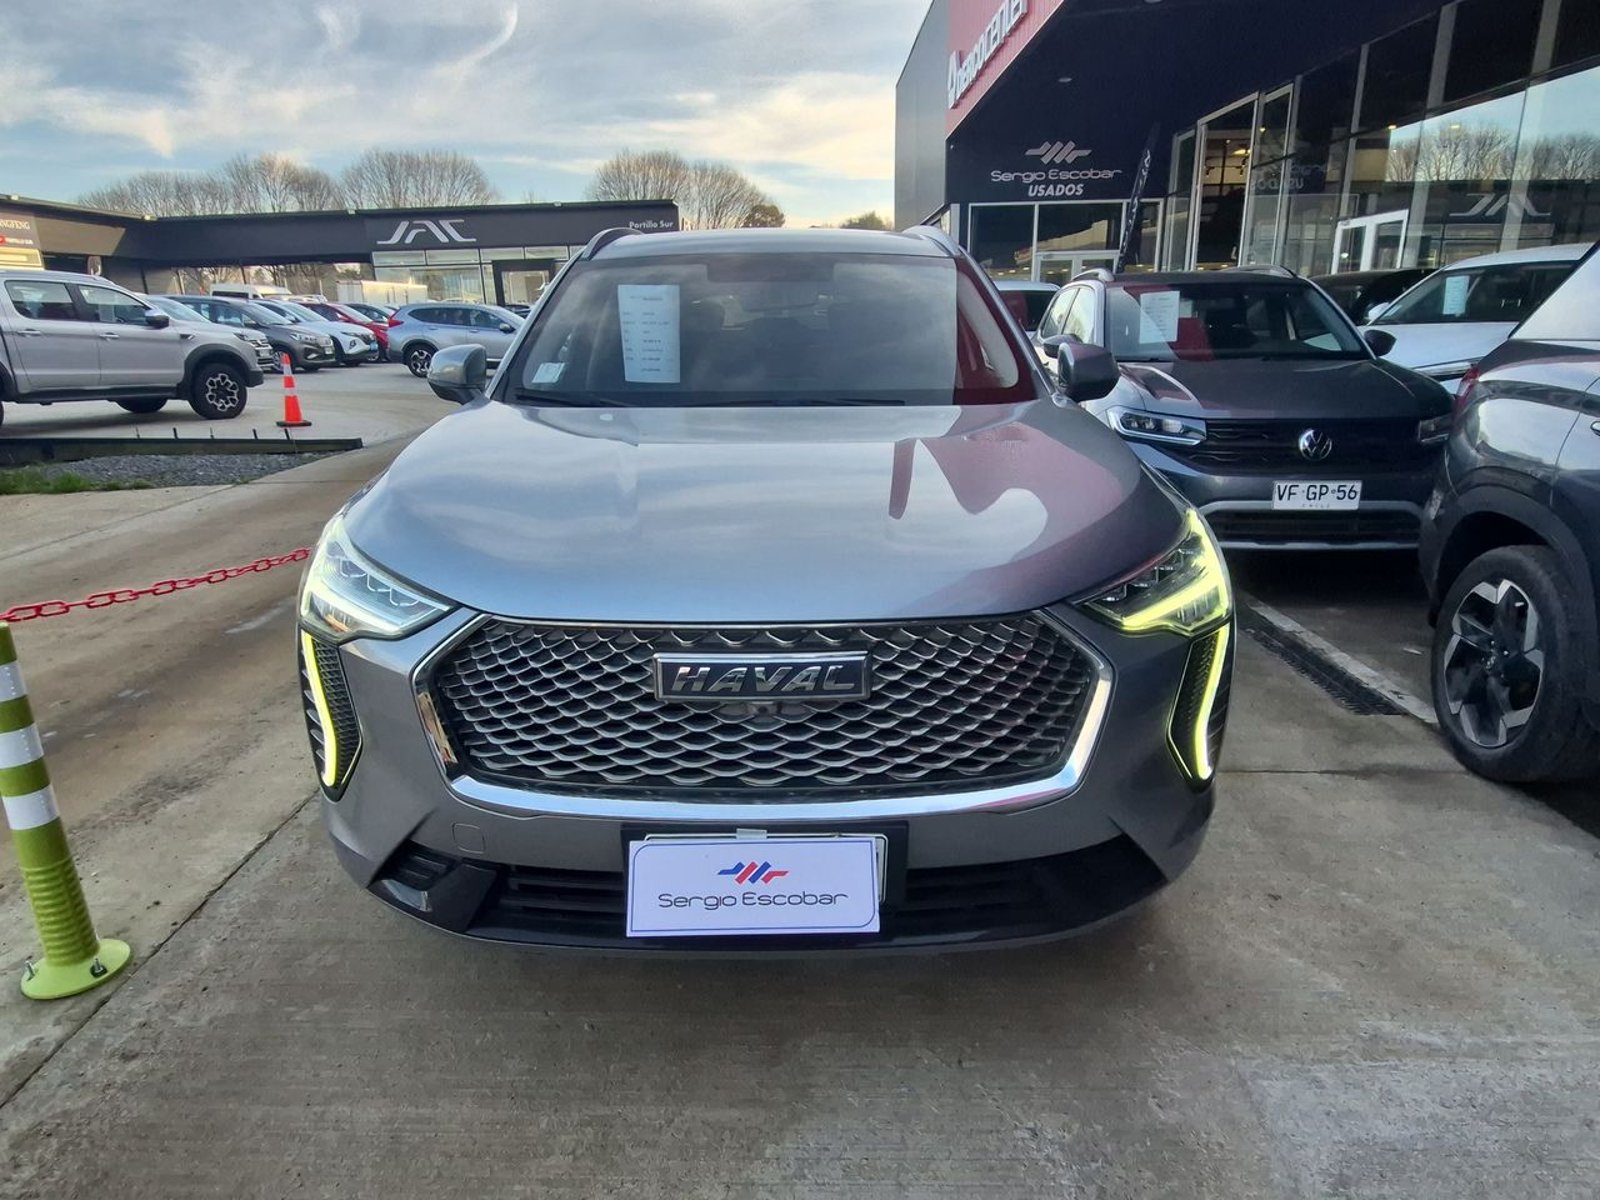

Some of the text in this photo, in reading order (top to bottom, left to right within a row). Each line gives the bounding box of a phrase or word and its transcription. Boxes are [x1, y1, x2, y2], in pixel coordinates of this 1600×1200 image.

[1048, 168, 1123, 181] Escobar
[1028, 184, 1084, 197] USADOS
[659, 220, 674, 229] Sur
[658, 891, 849, 911] Sergio Escobar
